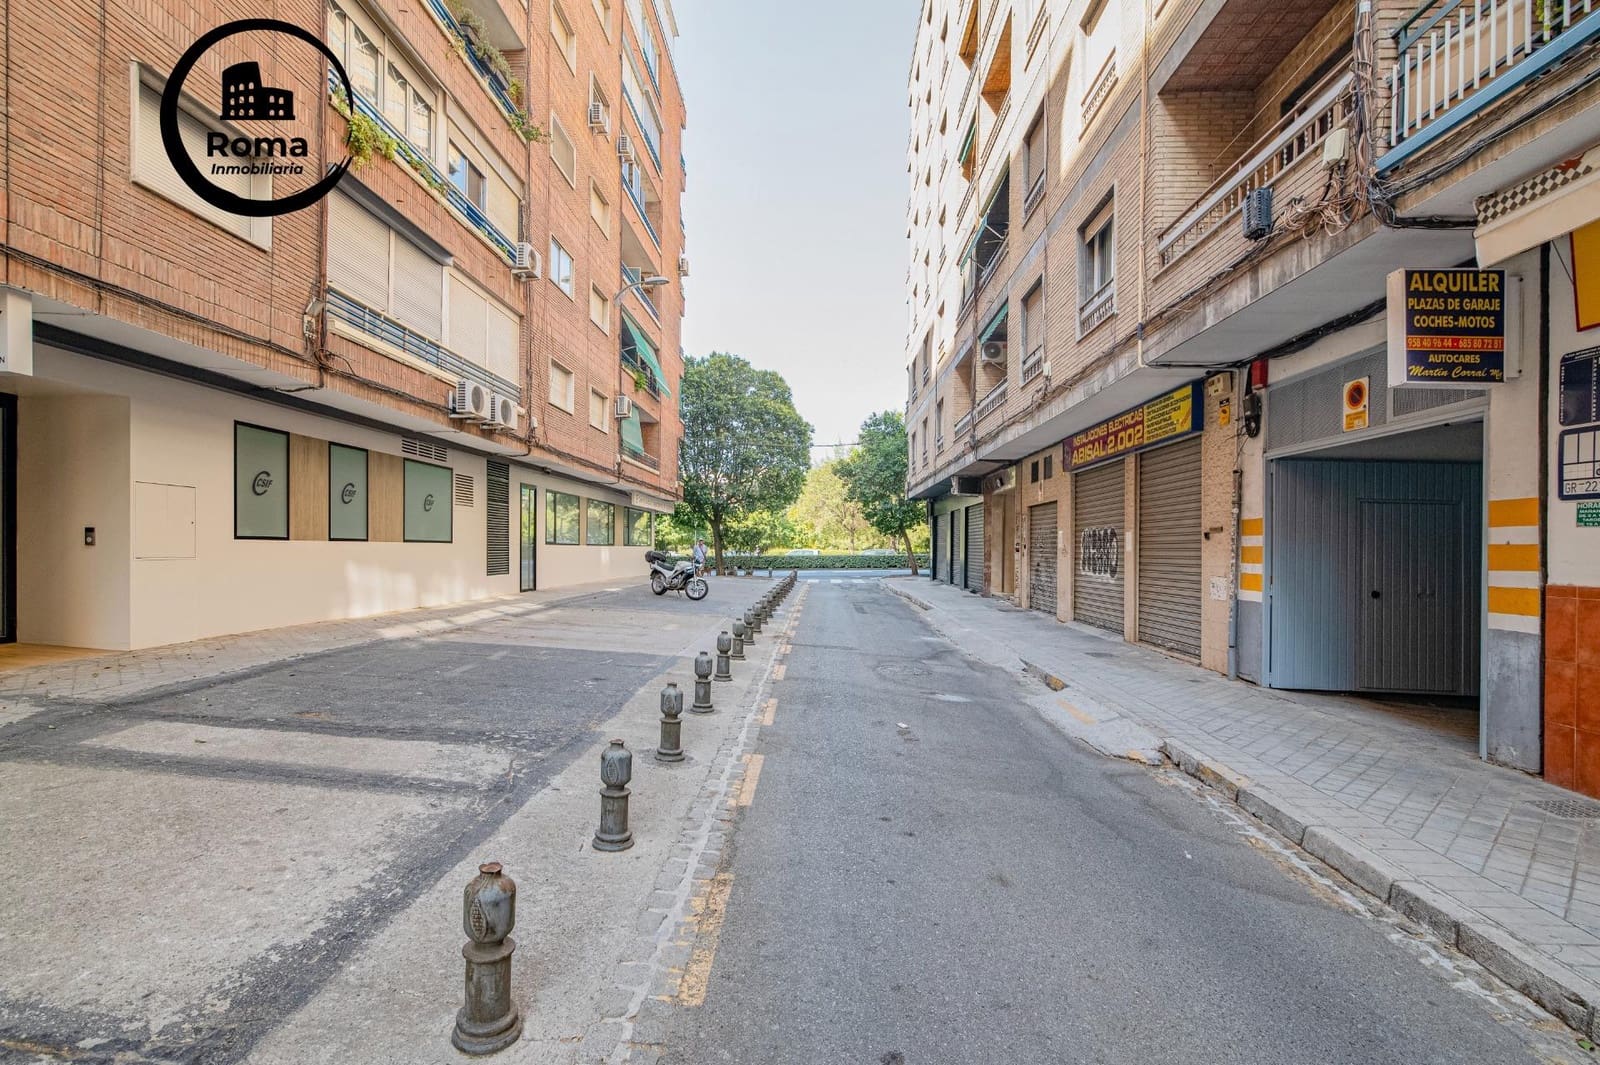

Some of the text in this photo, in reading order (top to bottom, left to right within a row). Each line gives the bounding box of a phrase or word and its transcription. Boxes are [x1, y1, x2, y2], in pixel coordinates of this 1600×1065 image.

[1409, 271, 1500, 294] ALQUILER
[1407, 297, 1501, 311] PLAZAS DE GARAJE
[1413, 315, 1496, 329] COCHES-MOTOS
[1428, 354, 1481, 364] AUTOCARES
[1071, 439, 1106, 467] ABISAL
[1107, 424, 1144, 455] 2.002
